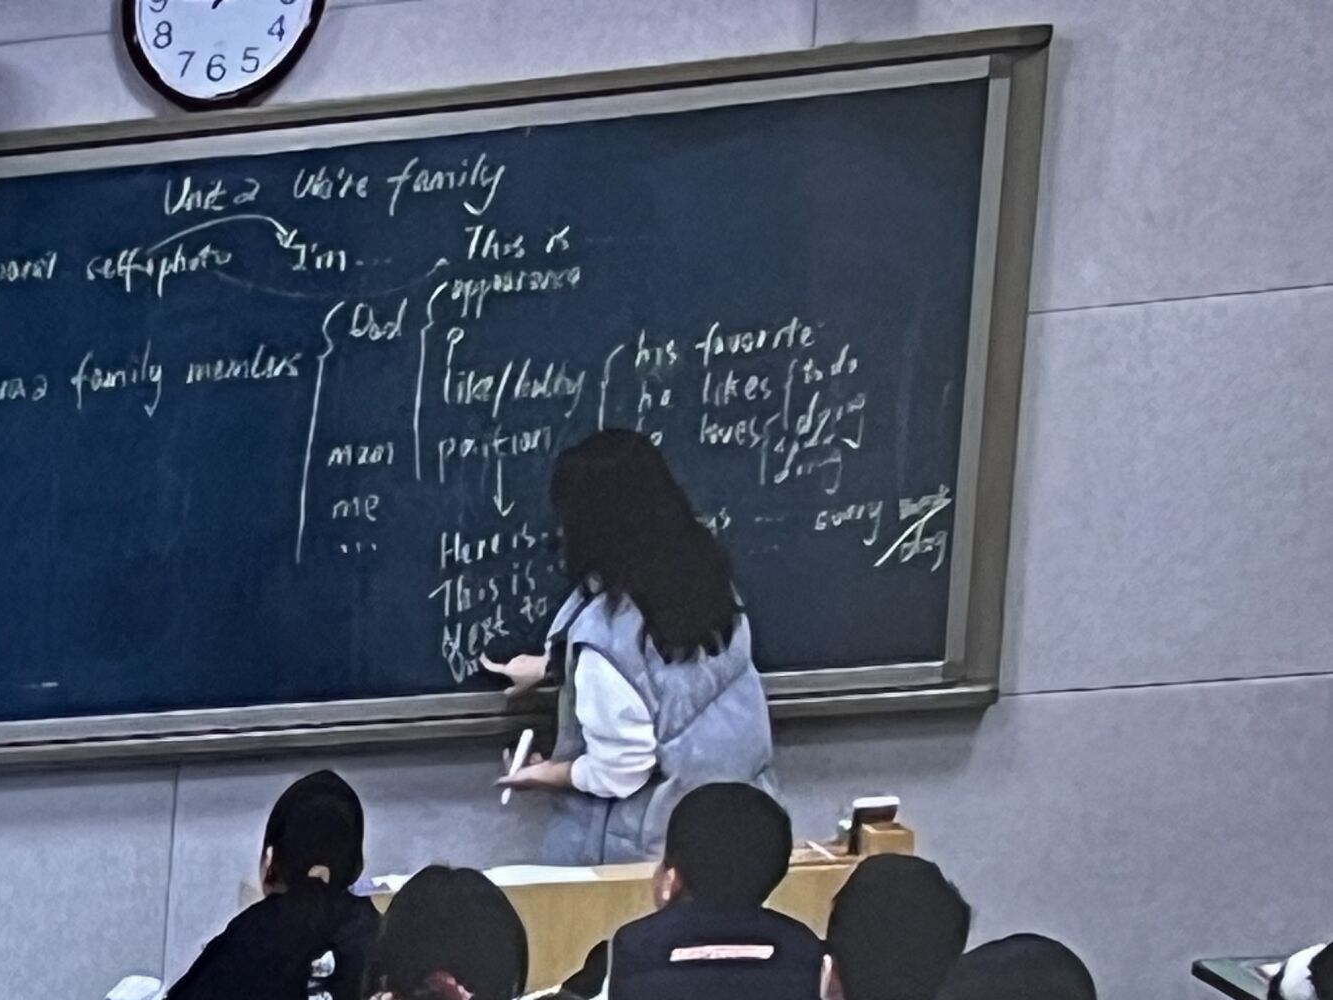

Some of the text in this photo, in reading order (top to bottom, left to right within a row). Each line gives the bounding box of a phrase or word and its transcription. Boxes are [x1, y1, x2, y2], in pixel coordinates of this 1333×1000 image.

[153, 20, 173, 49] 8
[267, 14, 286, 42] 4
[177, 50, 197, 78] 7
[206, 53, 227, 82] 6
[241, 46, 260, 74] 5
[386, 151, 507, 217] family
[69, 337, 164, 418] family
[702, 369, 773, 408] likes
[330, 493, 382, 523] me
